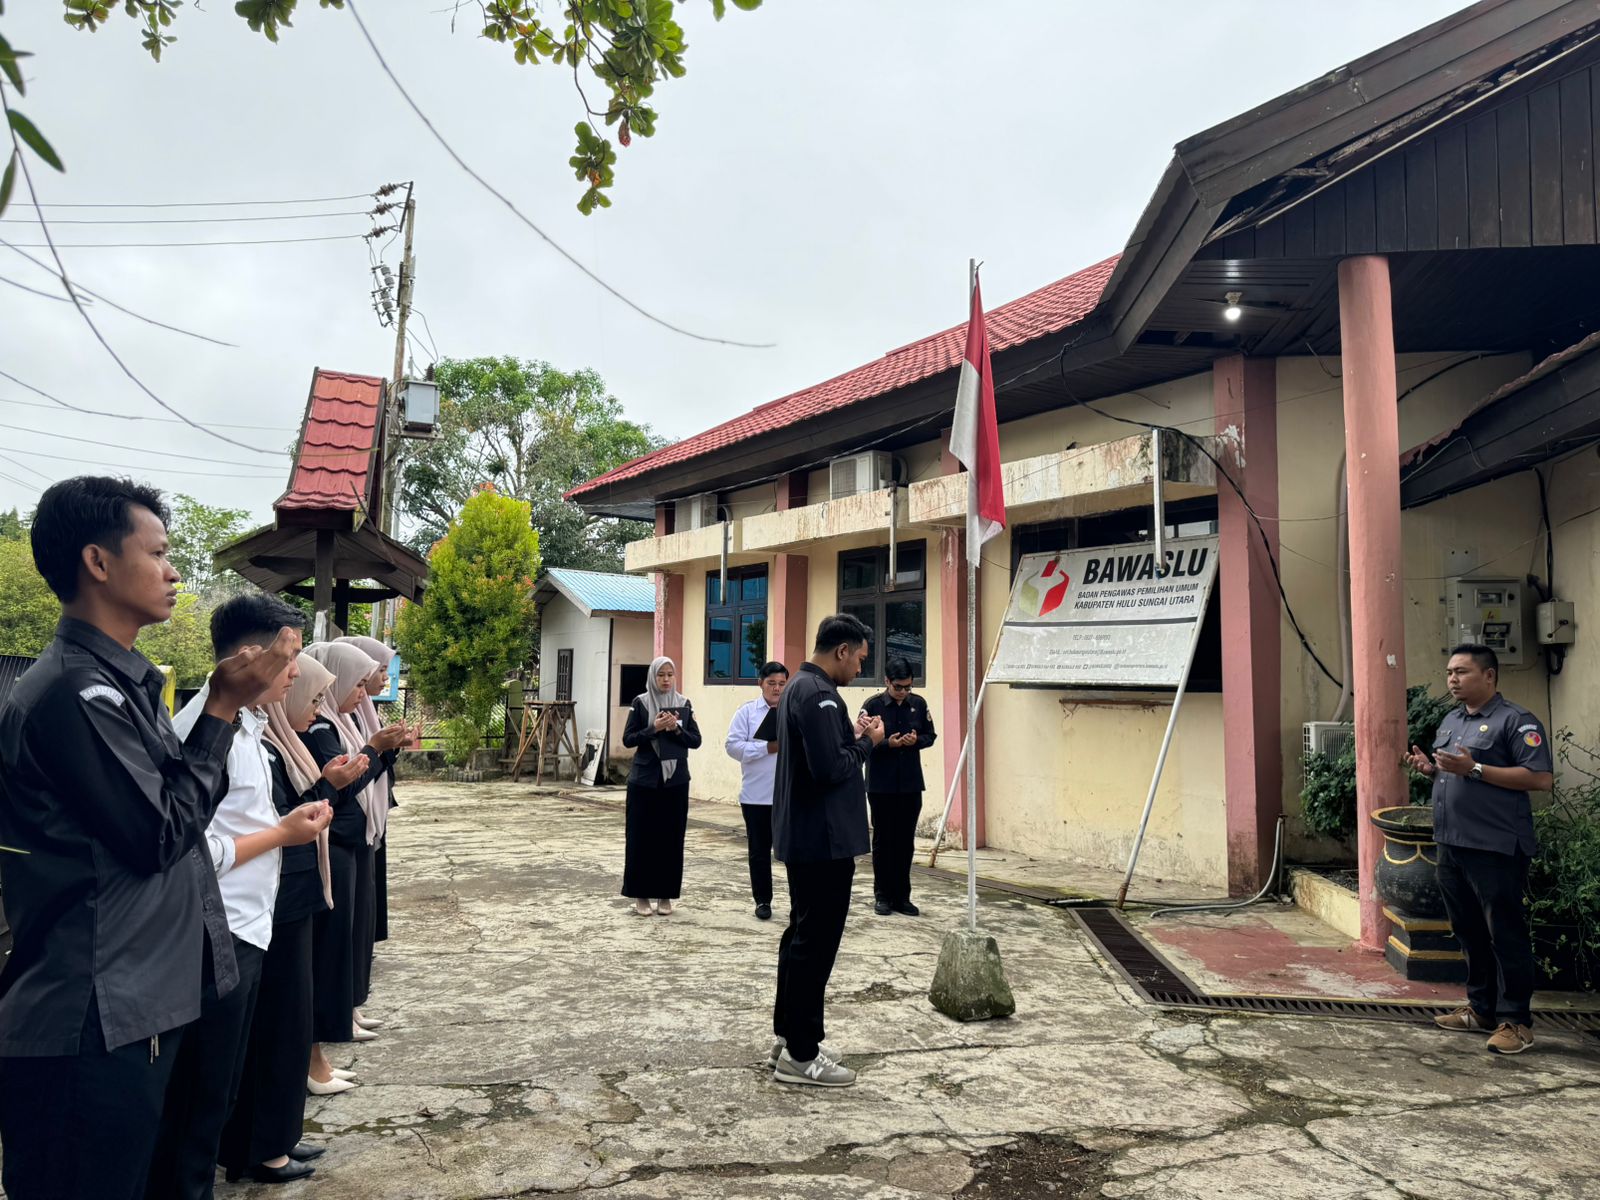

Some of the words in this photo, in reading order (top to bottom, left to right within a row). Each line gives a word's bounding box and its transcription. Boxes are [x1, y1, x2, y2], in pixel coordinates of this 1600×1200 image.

[1082, 547, 1209, 585] BAWASLU
[1077, 589, 1099, 599] BADAN
[1099, 587, 1136, 598] PENGAWAS
[1136, 584, 1174, 596] PEMILIHAN
[1175, 582, 1200, 593] UMUM
[1074, 599, 1115, 610] KABUPATEN
[1115, 598, 1137, 608] HULU
[1137, 596, 1168, 607] SUNGAI
[1169, 594, 1195, 605] UTARA
